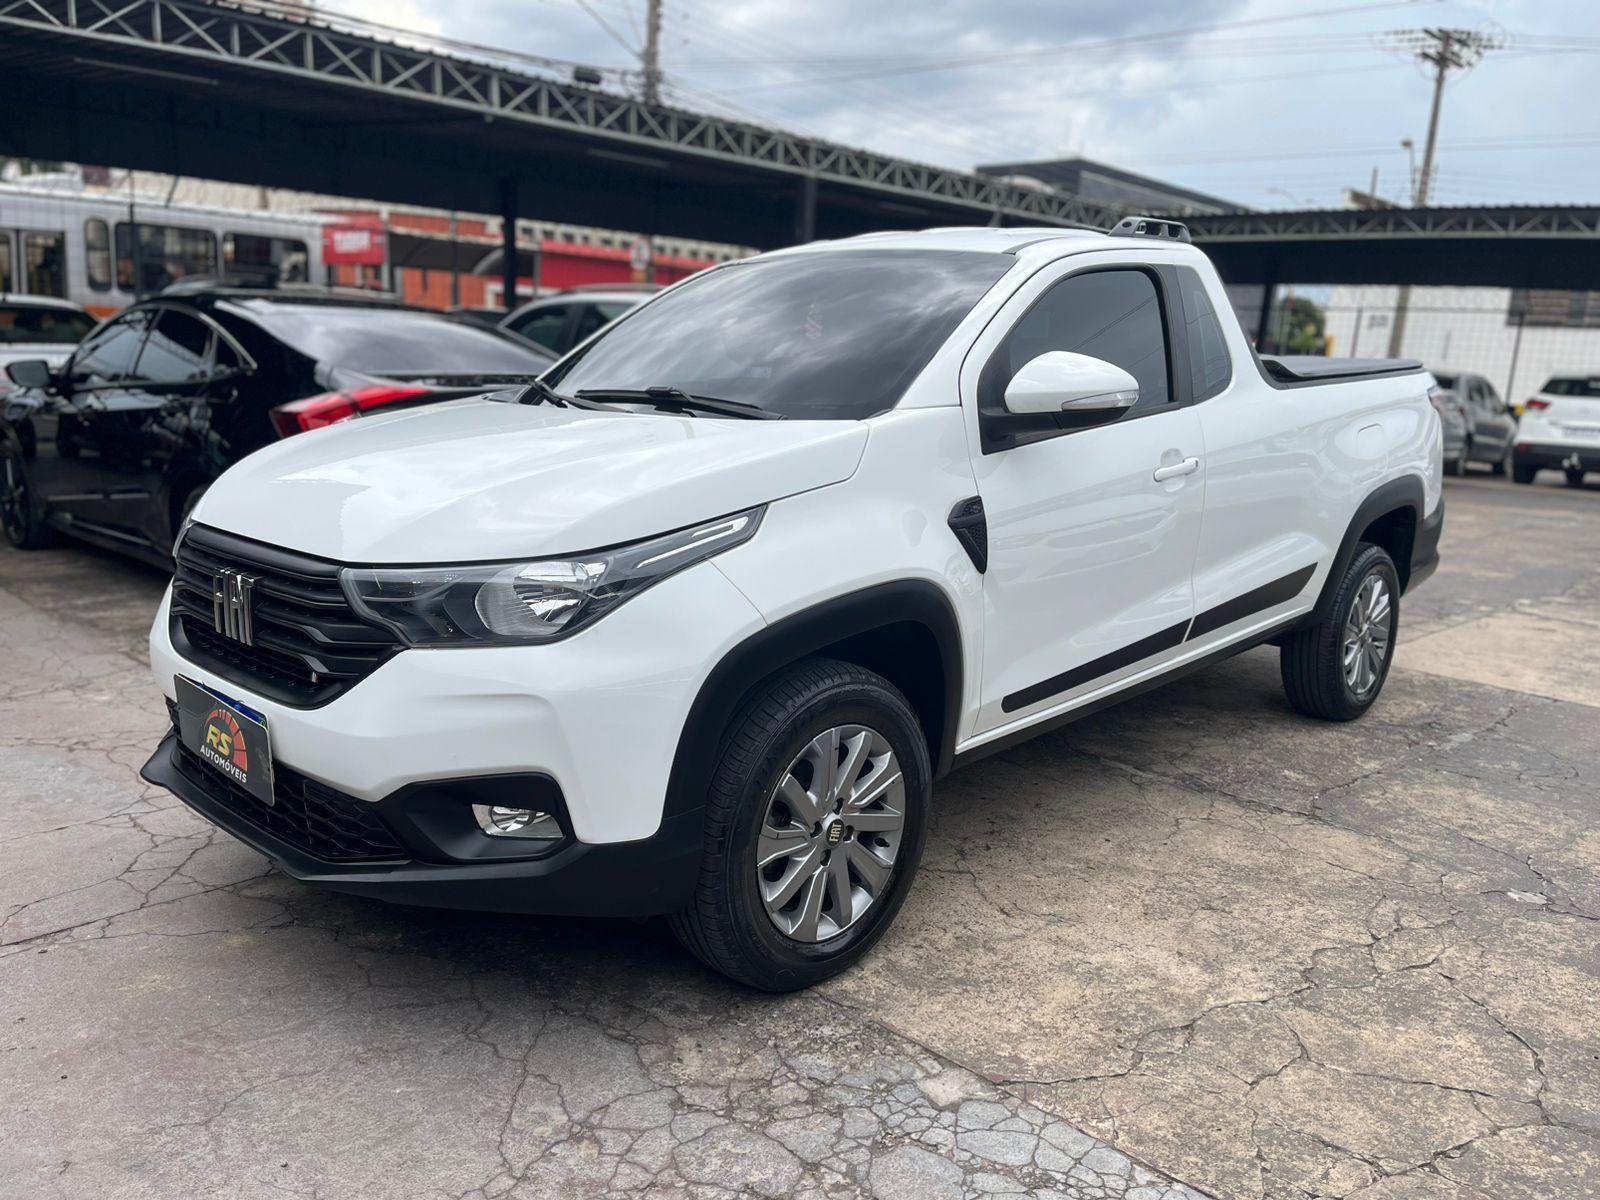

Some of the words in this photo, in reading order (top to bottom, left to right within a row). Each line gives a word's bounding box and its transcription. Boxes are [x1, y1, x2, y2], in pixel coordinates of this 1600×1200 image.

[213, 569, 255, 646] FIAT
[206, 724, 232, 756] RS
[200, 745, 247, 783] AUTOMÓVEIS
[829, 823, 842, 842] FIAT
